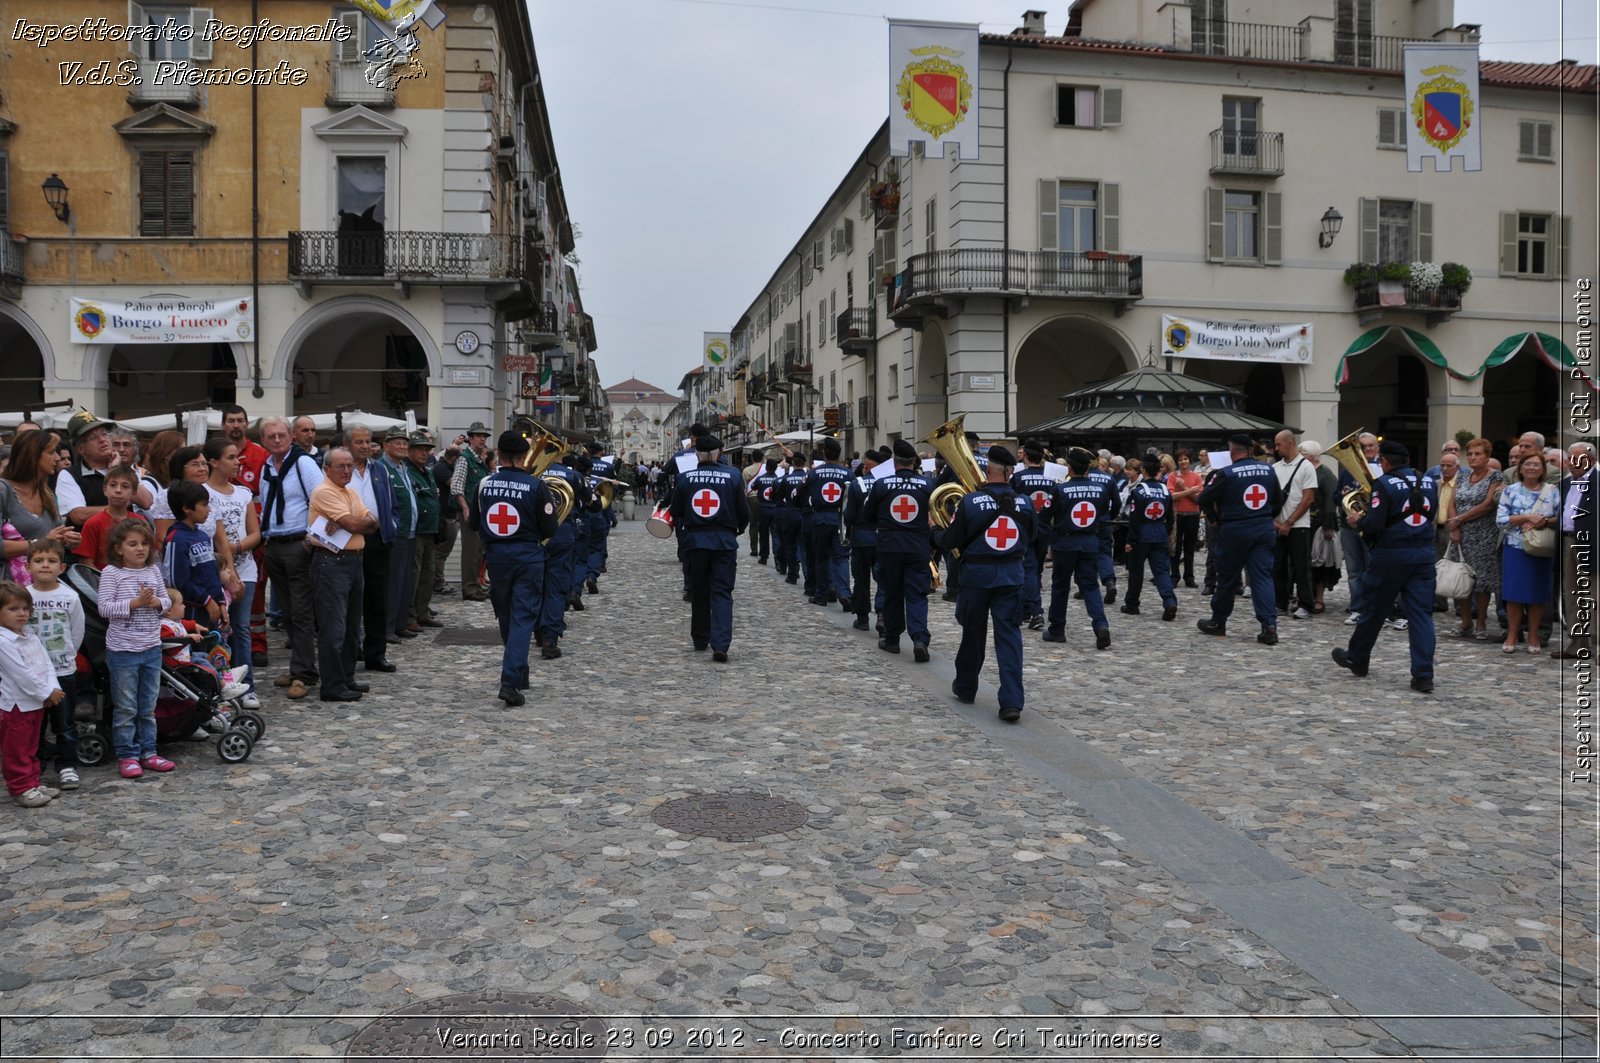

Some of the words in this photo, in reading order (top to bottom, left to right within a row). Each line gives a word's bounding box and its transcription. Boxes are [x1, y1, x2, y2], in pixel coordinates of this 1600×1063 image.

[125, 302, 152, 312] Palio
[157, 302, 174, 311] dei
[178, 301, 214, 313] Borghi
[112, 315, 162, 332] Borgo
[168, 314, 227, 328] Trucco
[1232, 323, 1247, 332] dei
[1250, 321, 1281, 335] Borghi
[1197, 333, 1232, 349] Borgo
[1235, 335, 1261, 347] Polo
[1263, 337, 1291, 349] Nord
[690, 476, 725, 484] FANFARA
[484, 488, 522, 499] FANFARA
